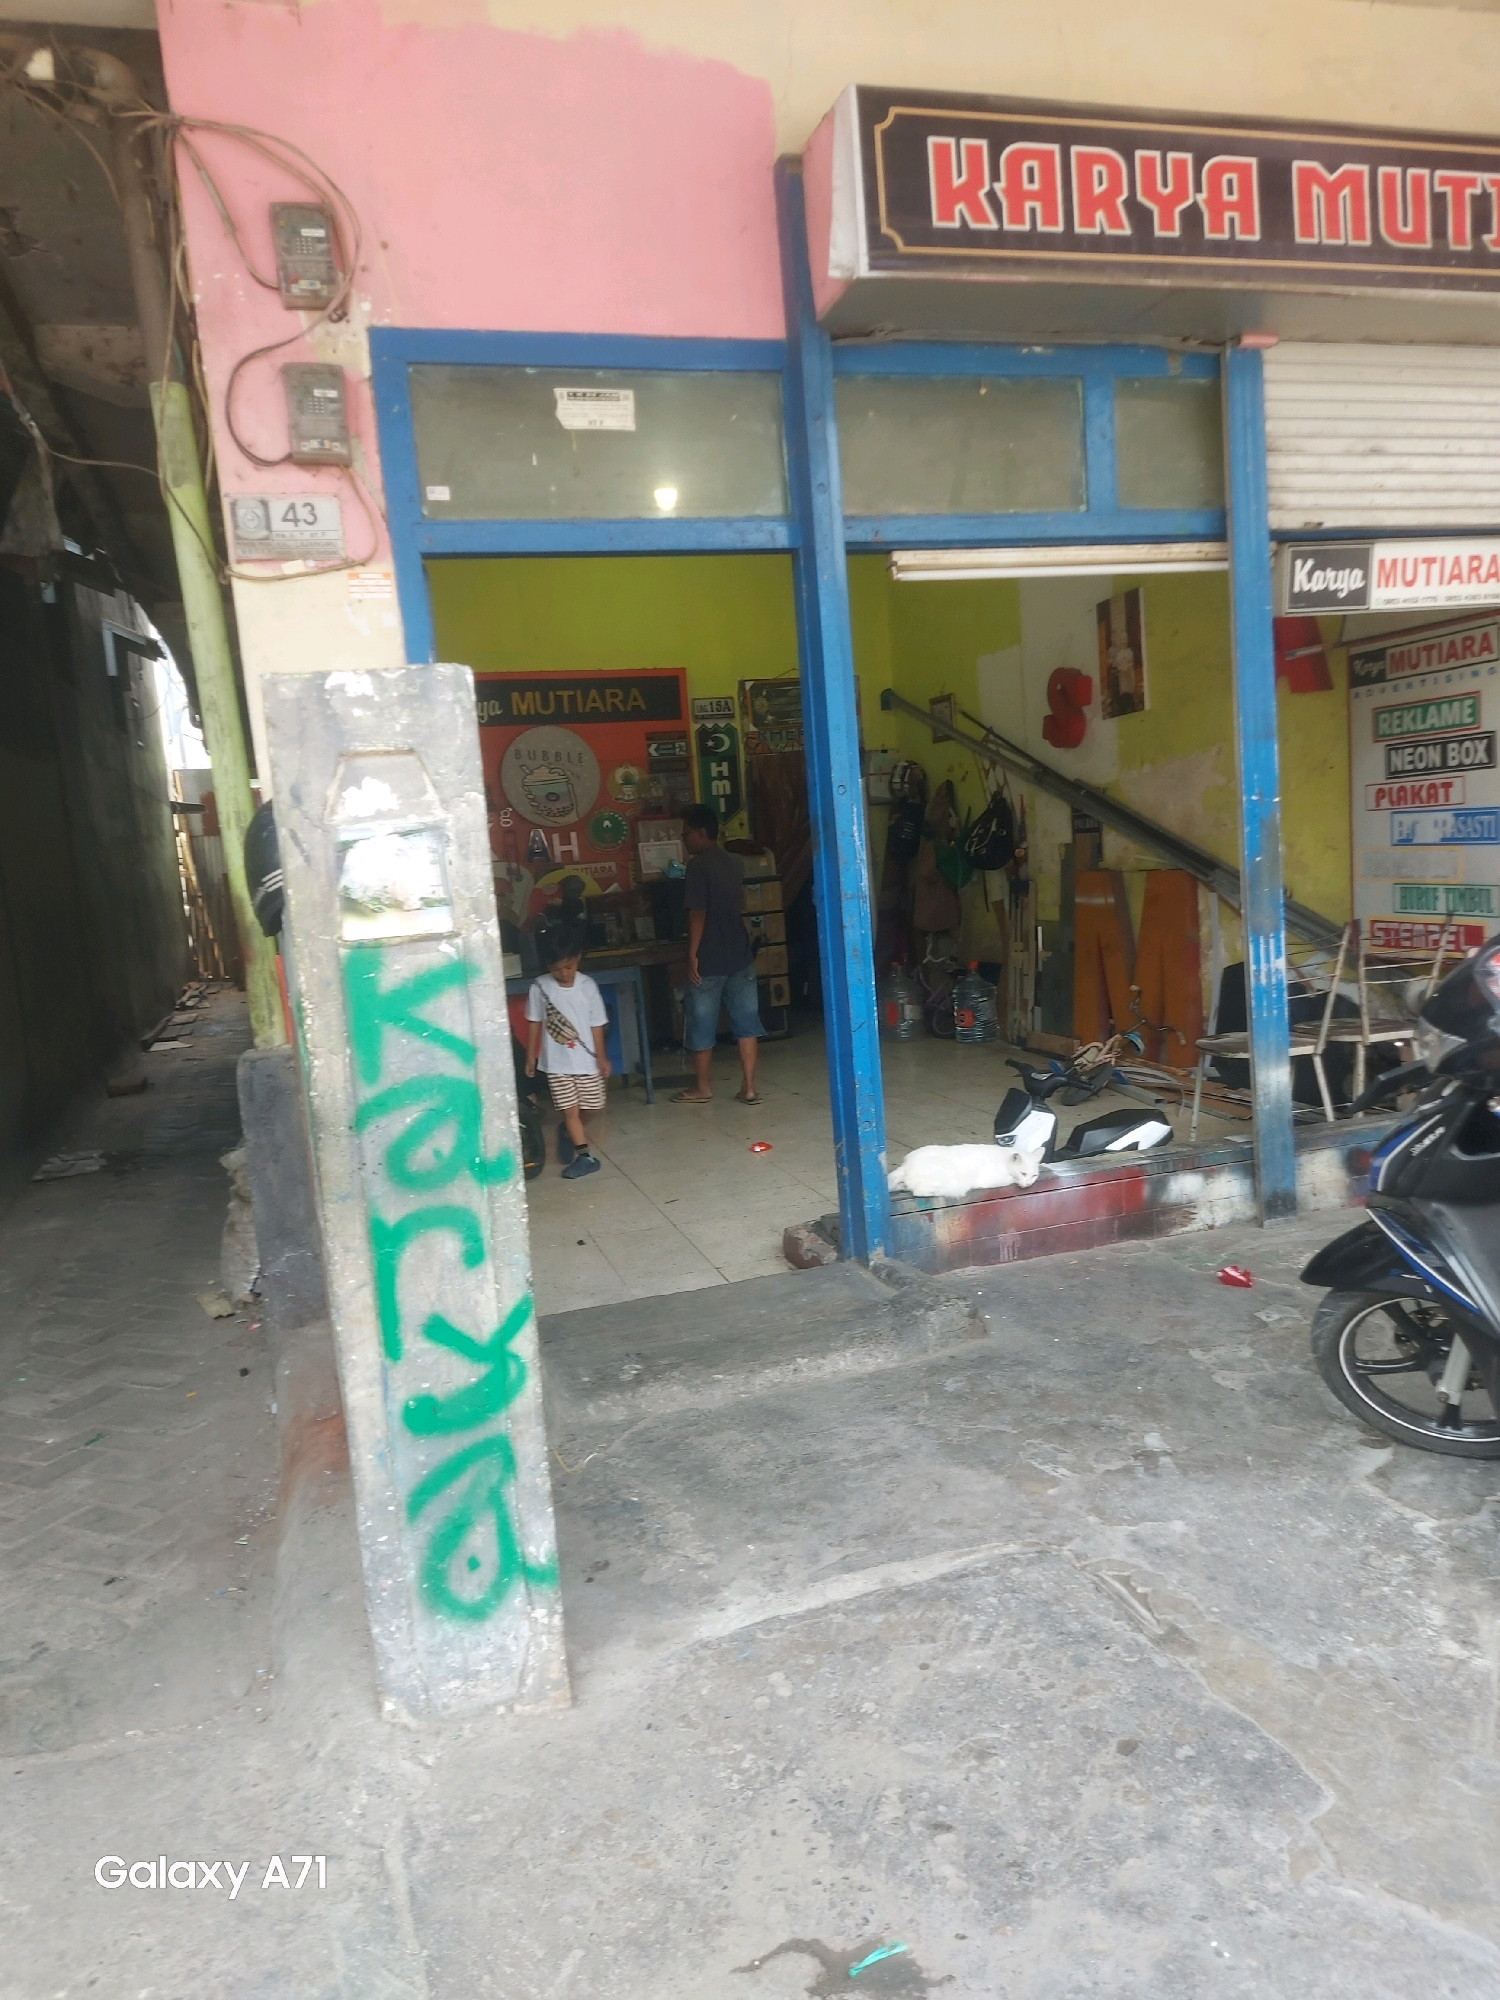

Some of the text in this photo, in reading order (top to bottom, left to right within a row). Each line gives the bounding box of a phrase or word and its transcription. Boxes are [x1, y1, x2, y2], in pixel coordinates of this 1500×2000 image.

[927, 135, 1260, 241] KARYA
[281, 502, 318, 527] 43
[1293, 554, 1500, 599] Karya MUTIARA
[1389, 631, 1495, 675] MUTIARA
[510, 687, 647, 716] MUTIARA
[1378, 698, 1476, 735] REKLAME
[514, 748, 585, 765] BUBBLE
[1390, 738, 1489, 772] NEON BOX
[710, 761, 732, 813] HMI
[1375, 781, 1454, 808] PLAKAT
